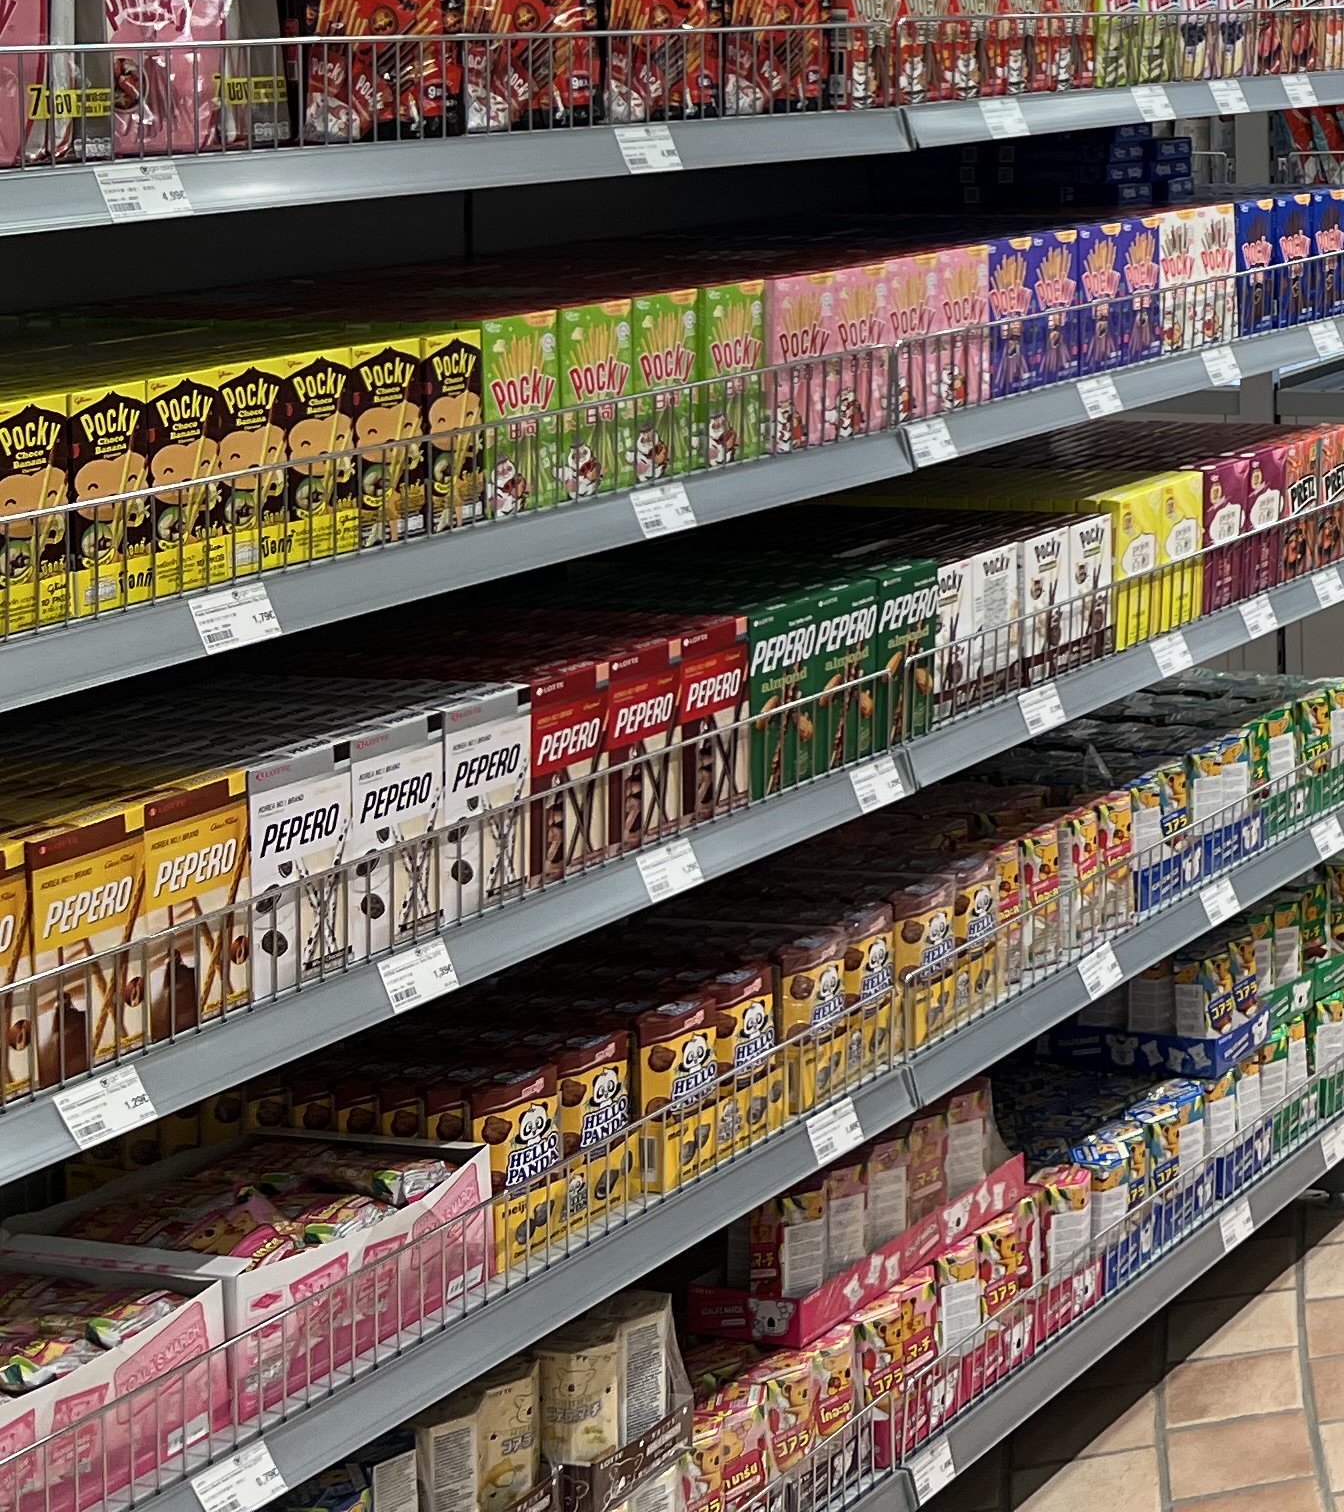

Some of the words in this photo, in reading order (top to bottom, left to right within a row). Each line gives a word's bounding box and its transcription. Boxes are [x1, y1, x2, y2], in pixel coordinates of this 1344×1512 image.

[97, 436, 124, 446] Choco
[170, 429, 201, 440] Banana
[172, 421, 198, 431] Choco
[12, 458, 47, 470] Banana
[95, 443, 127, 455] Banana
[815, 604, 878, 656] PEPERO
[878, 584, 940, 634] PEPERO
[750, 624, 817, 677] PEPERO
[686, 668, 741, 712] PEPERO
[614, 692, 674, 738] PEPERO
[537, 717, 601, 766] PEPERO
[452, 743, 521, 792] PEPERO
[360, 772, 432, 824] PEPERO
[260, 802, 340, 859] PEPERO
[153, 838, 237, 899] PEPERO
[43, 876, 133, 939] PEPERO
[736, 1029, 775, 1061] HELLO
[673, 1061, 718, 1095] HELLO
[580, 1112, 628, 1148] PANDA
[583, 1095, 628, 1130] HELLO
[506, 1147, 559, 1187] PANDA
[509, 1132, 560, 1169] HELLO
